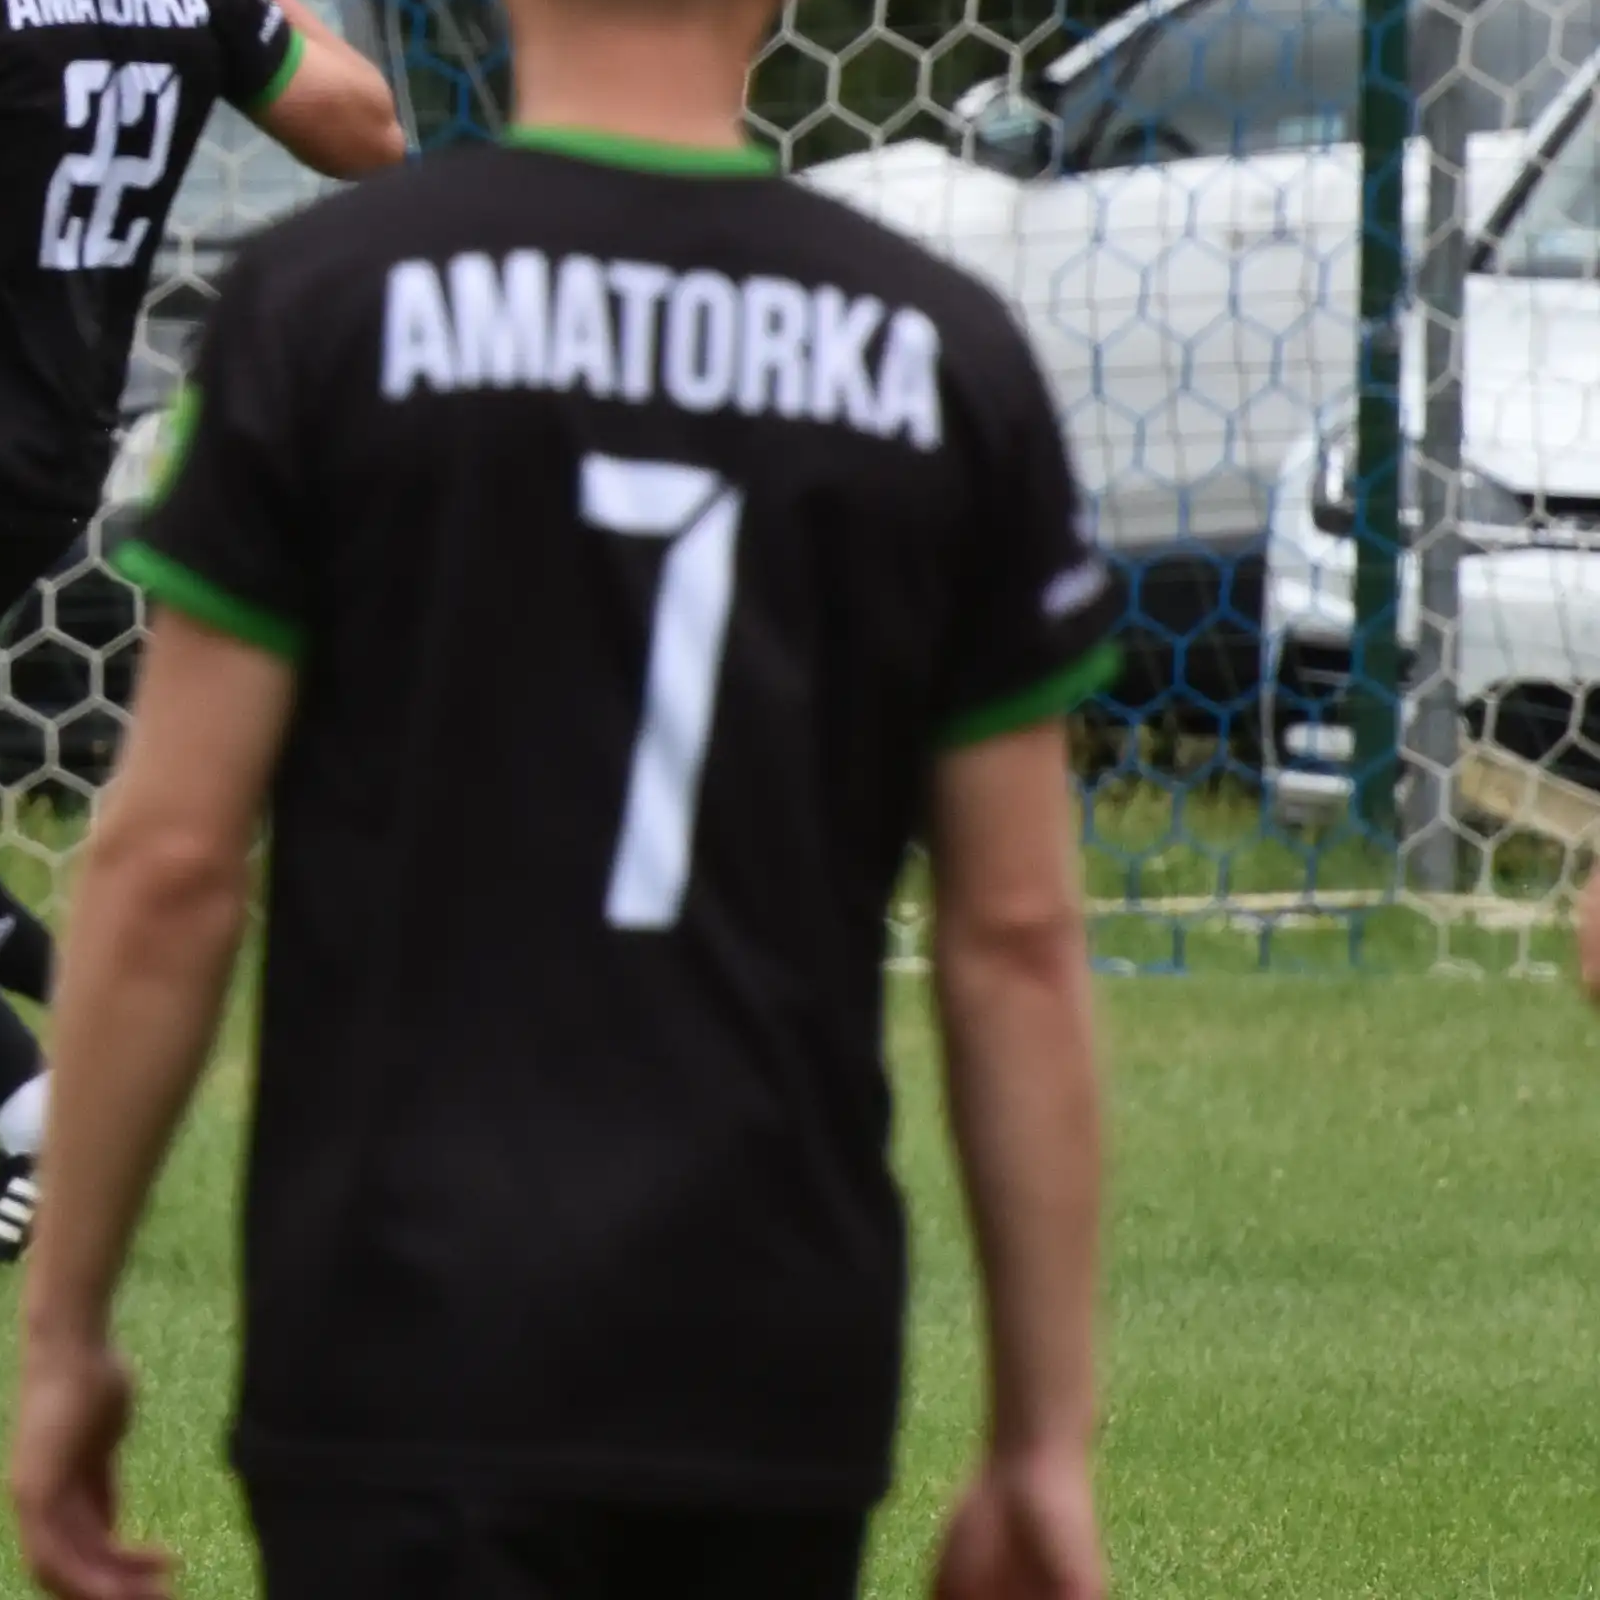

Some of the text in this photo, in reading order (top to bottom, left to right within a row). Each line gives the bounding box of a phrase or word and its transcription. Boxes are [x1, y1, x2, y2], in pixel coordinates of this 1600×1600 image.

[39, 58, 179, 272] 22
[380, 246, 944, 453] AMATORKA
[581, 453, 739, 929] 7
